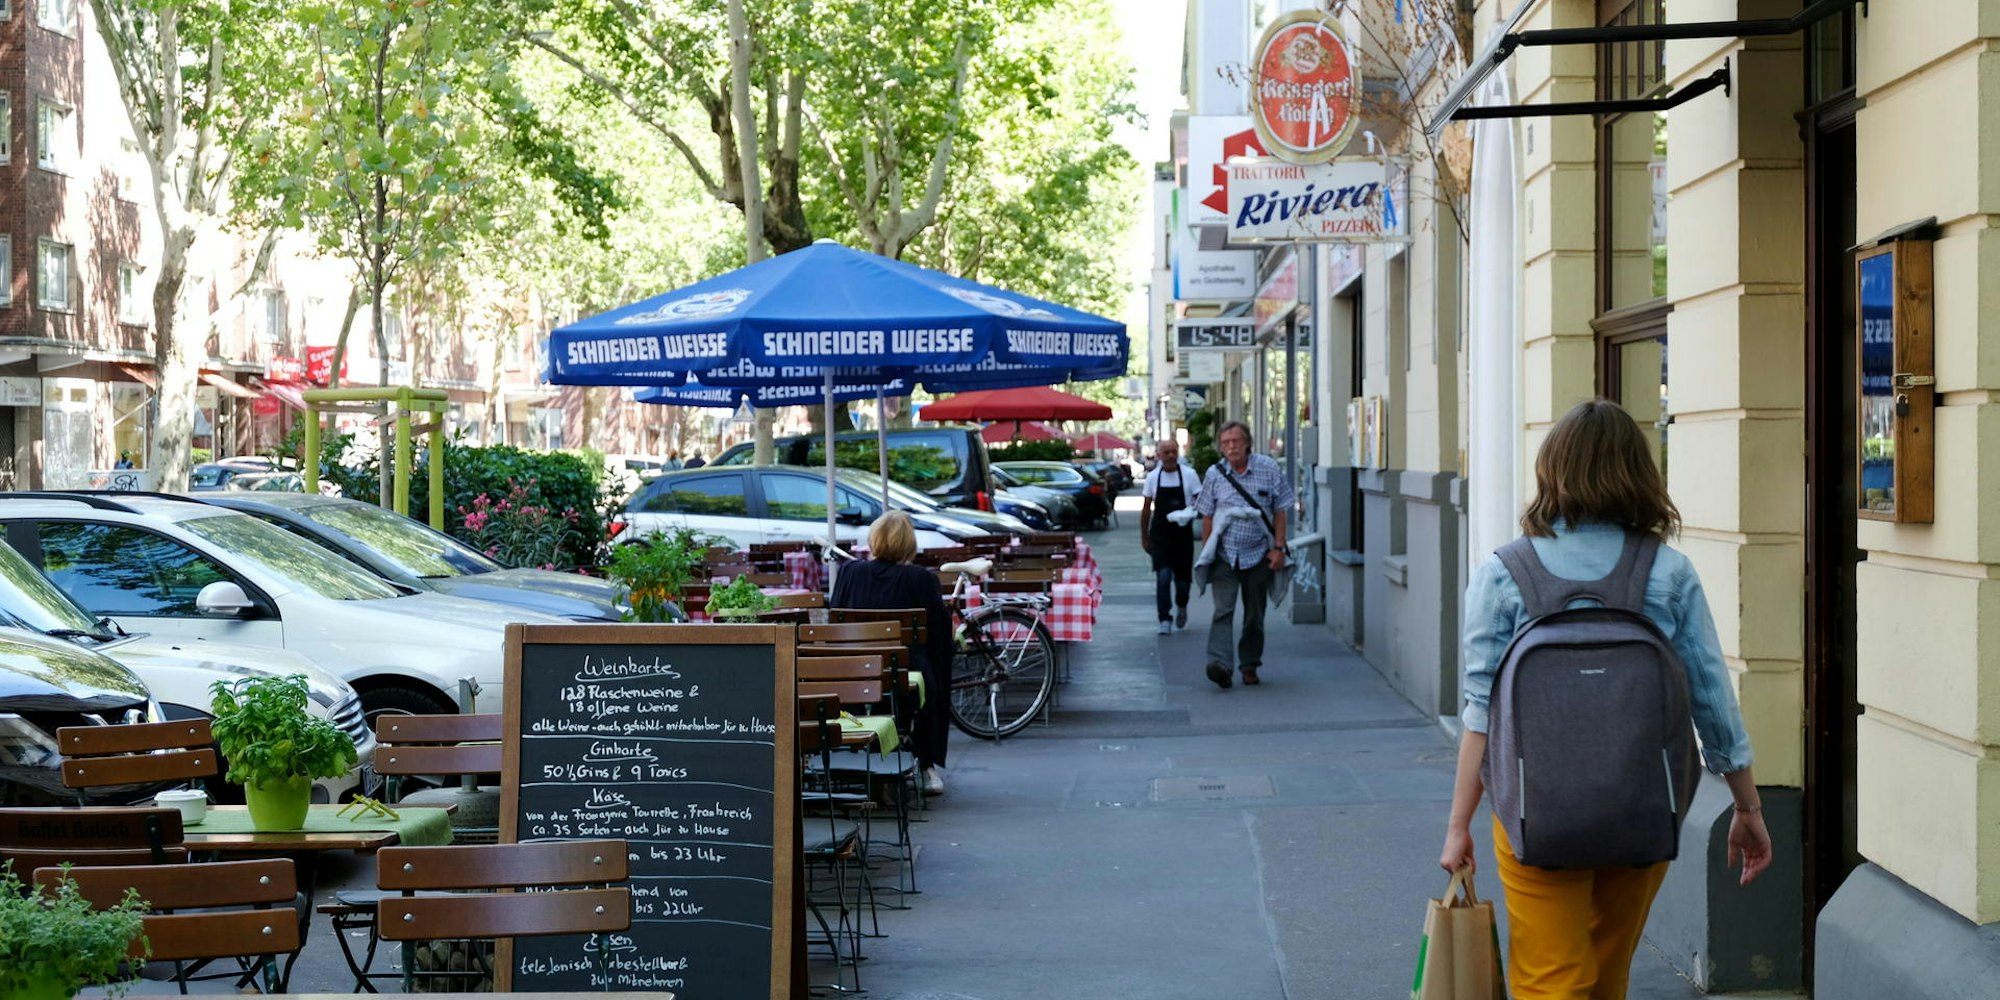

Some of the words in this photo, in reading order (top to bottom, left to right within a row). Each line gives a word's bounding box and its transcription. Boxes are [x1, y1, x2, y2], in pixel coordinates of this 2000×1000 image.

[1233, 166, 1305, 180] TRATTORIA
[1236, 182, 1379, 229] Riviera
[1321, 219, 1382, 233] PIZZERIA
[763, 329, 885, 356] SCHNEIDER
[891, 328, 974, 353] WEISSE
[1006, 329, 1071, 356] SCHNEIDER
[1073, 332, 1121, 358] WEISSE
[1191, 326, 1251, 346] 15:48
[568, 336, 660, 365] SCHNEIDER
[663, 332, 727, 359] WEISSE
[584, 655, 673, 677] Weinkarte
[561, 685, 585, 701] 128
[587, 685, 684, 699] Flaschenweine
[689, 685, 700, 697] &
[570, 701, 584, 713] 18
[587, 700, 630, 720] offene
[637, 702, 679, 713] Weine
[532, 718, 555, 732] alle
[721, 719, 736, 734] für
[590, 741, 653, 759] Ginkarte
[577, 765, 609, 778] Gins
[612, 766, 621, 780] &
[631, 765, 641, 780] 9
[648, 763, 688, 778] Tonics
[593, 788, 625, 803] Käse
[526, 812, 544, 821] von
[550, 811, 568, 821] der
[572, 808, 627, 824] Fromagerie
[688, 802, 752, 821] Frankreich
[532, 825, 550, 835] ca.
[553, 824, 571, 836] 35
[578, 823, 611, 836] Sorten
[624, 822, 649, 835] auch
[652, 824, 672, 837] für
[678, 825, 689, 834] zu
[694, 823, 730, 836] Hause
[650, 846, 669, 860] bis
[674, 847, 692, 861] 23
[697, 847, 726, 863] Uhr
[669, 886, 688, 897] von
[635, 899, 653, 914] bis
[591, 933, 632, 946] Esen
[520, 956, 592, 976] telefonisch
[618, 974, 684, 988] Mitnehmen
